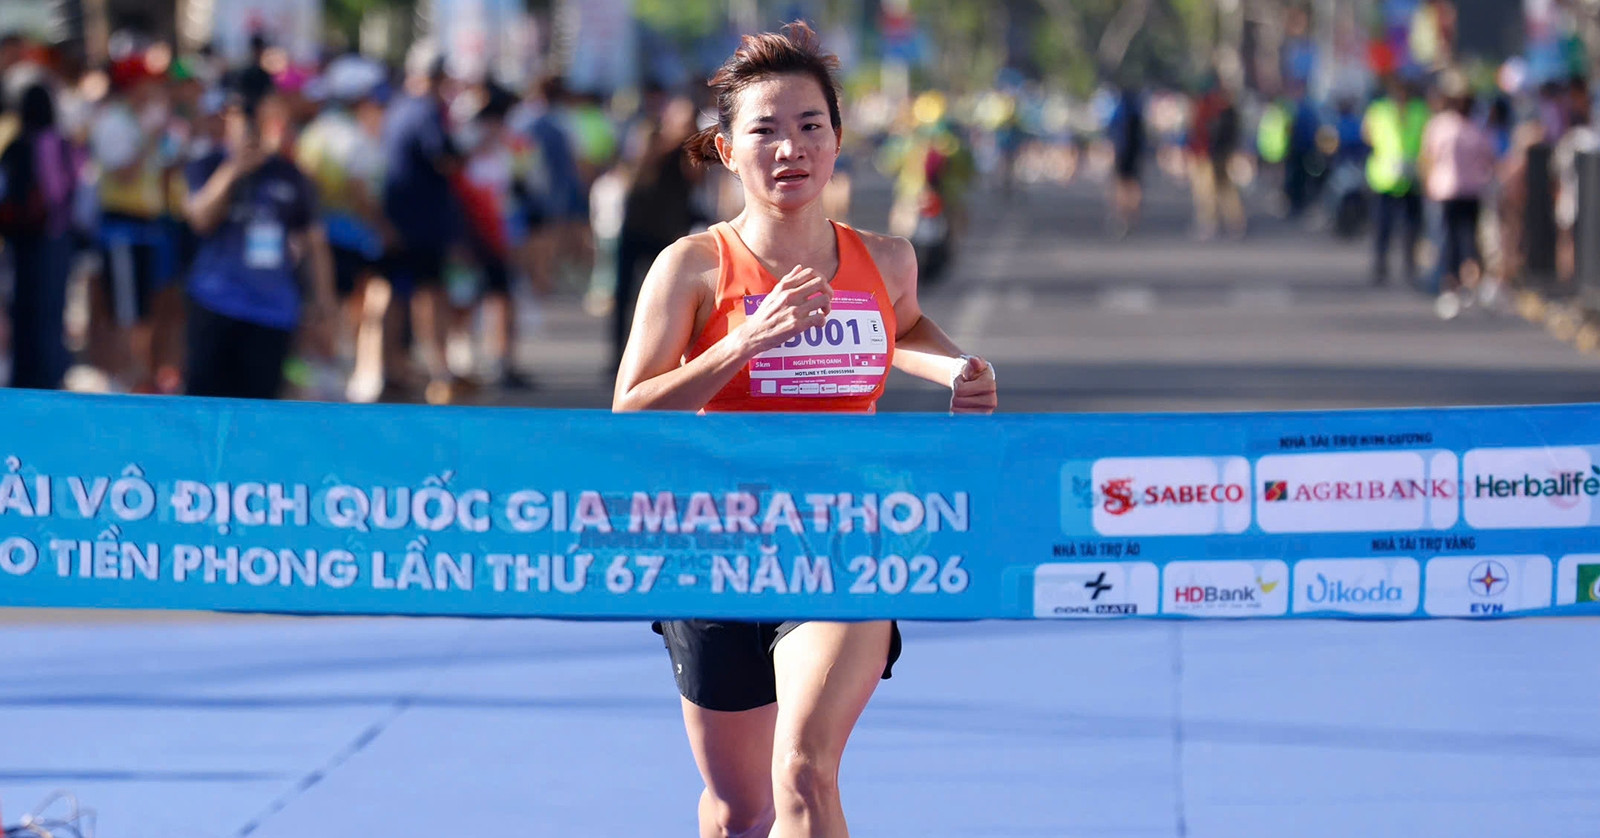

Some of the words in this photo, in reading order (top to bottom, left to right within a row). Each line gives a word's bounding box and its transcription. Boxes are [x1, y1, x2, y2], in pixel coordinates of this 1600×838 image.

[769, 318, 861, 349] 001
[872, 323, 879, 332] E
[1144, 484, 1244, 504] SABECO
[1294, 479, 1449, 501] AGRIBANK
[1475, 471, 1600, 499] Herbalife
[67, 463, 157, 521] VÔ
[171, 480, 309, 535] ĐỊCH
[324, 470, 492, 532] QUỐC
[506, 489, 614, 533] GIA
[628, 491, 970, 534] MARATHON
[50, 524, 160, 580] TIỀN
[173, 545, 359, 588] PHONG
[371, 535, 474, 591] LẦN
[486, 544, 594, 593] THỨ
[605, 555, 667, 594] 67
[678, 573, 699, 587] -
[711, 545, 836, 594] NĂM
[848, 554, 970, 595] 2026
[1175, 586, 1256, 602] HDBank
[1306, 573, 1403, 604] Vikoda
[1470, 603, 1503, 614] EVN
